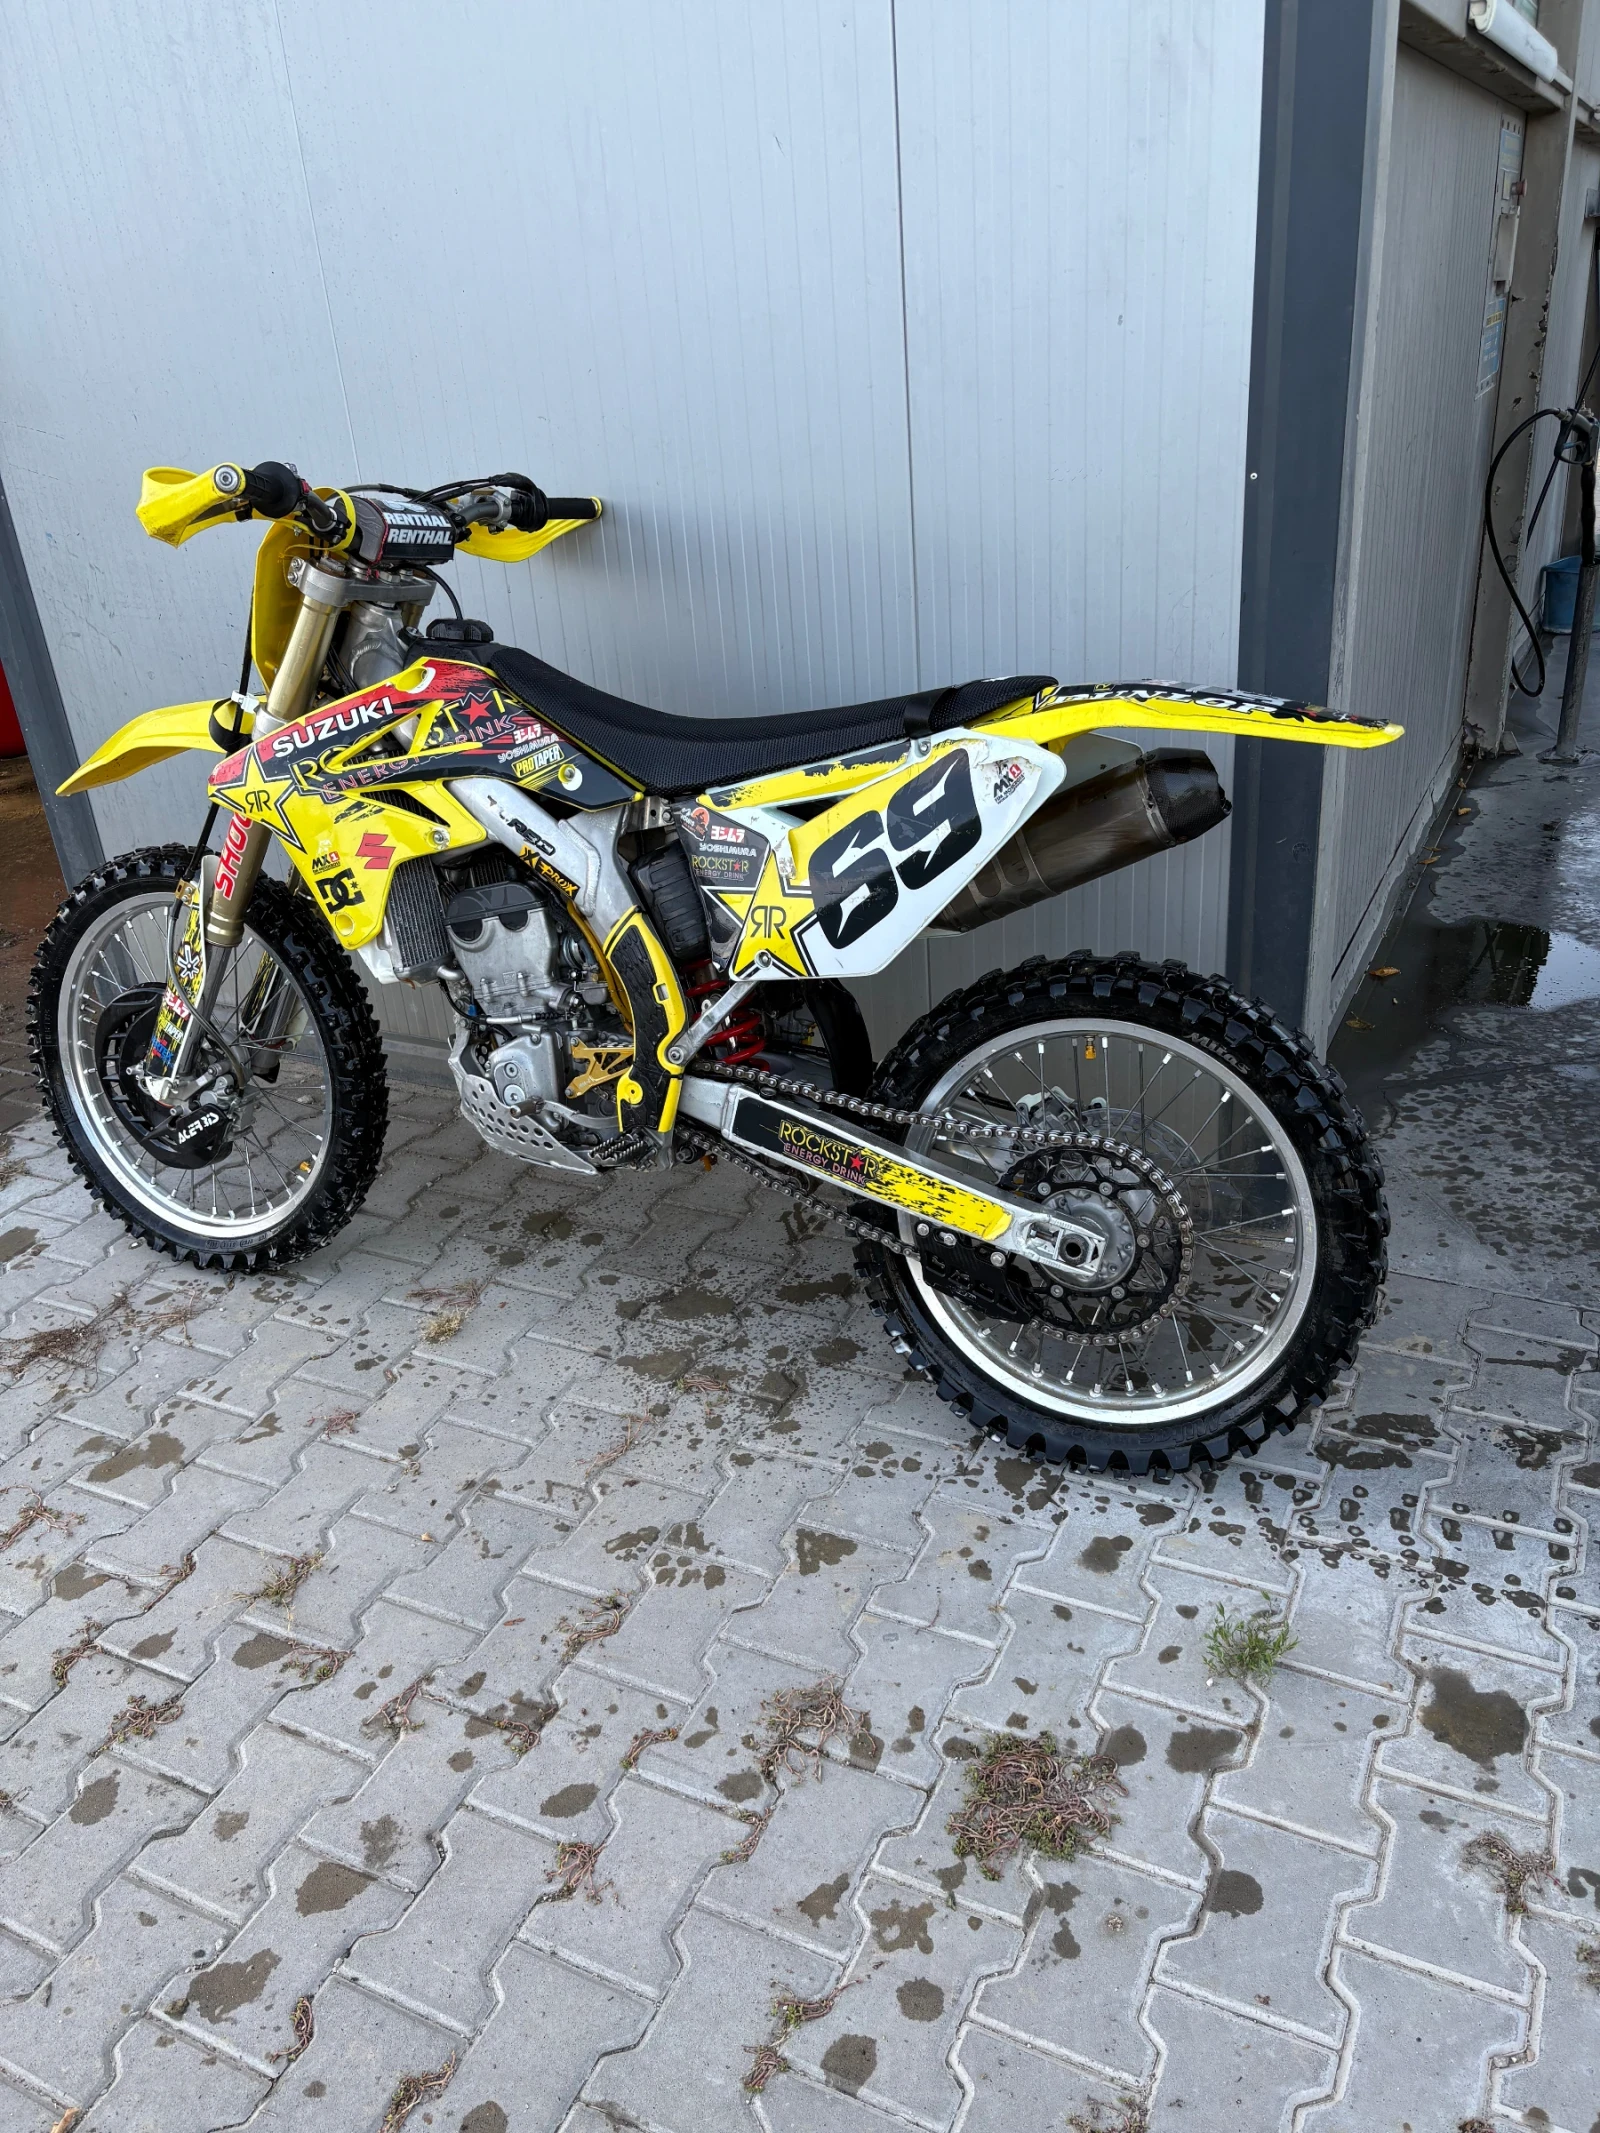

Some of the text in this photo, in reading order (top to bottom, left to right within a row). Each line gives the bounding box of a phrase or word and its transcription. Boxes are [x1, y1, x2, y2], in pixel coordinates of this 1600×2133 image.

[383, 511, 452, 528] RENTHAL
[387, 528, 453, 545] RENTHAL
[1045, 690, 1278, 714] DUNLOP
[272, 697, 394, 758] SUZUKI
[441, 714, 512, 748] RINK
[312, 851, 340, 870] MX1
[699, 843, 757, 857] YOSHIMURA
[808, 748, 982, 950] 69
[723, 871, 744, 880] DRINK
[315, 868, 365, 914] DC
[784, 1143, 866, 1185] ENERGY DRINK
